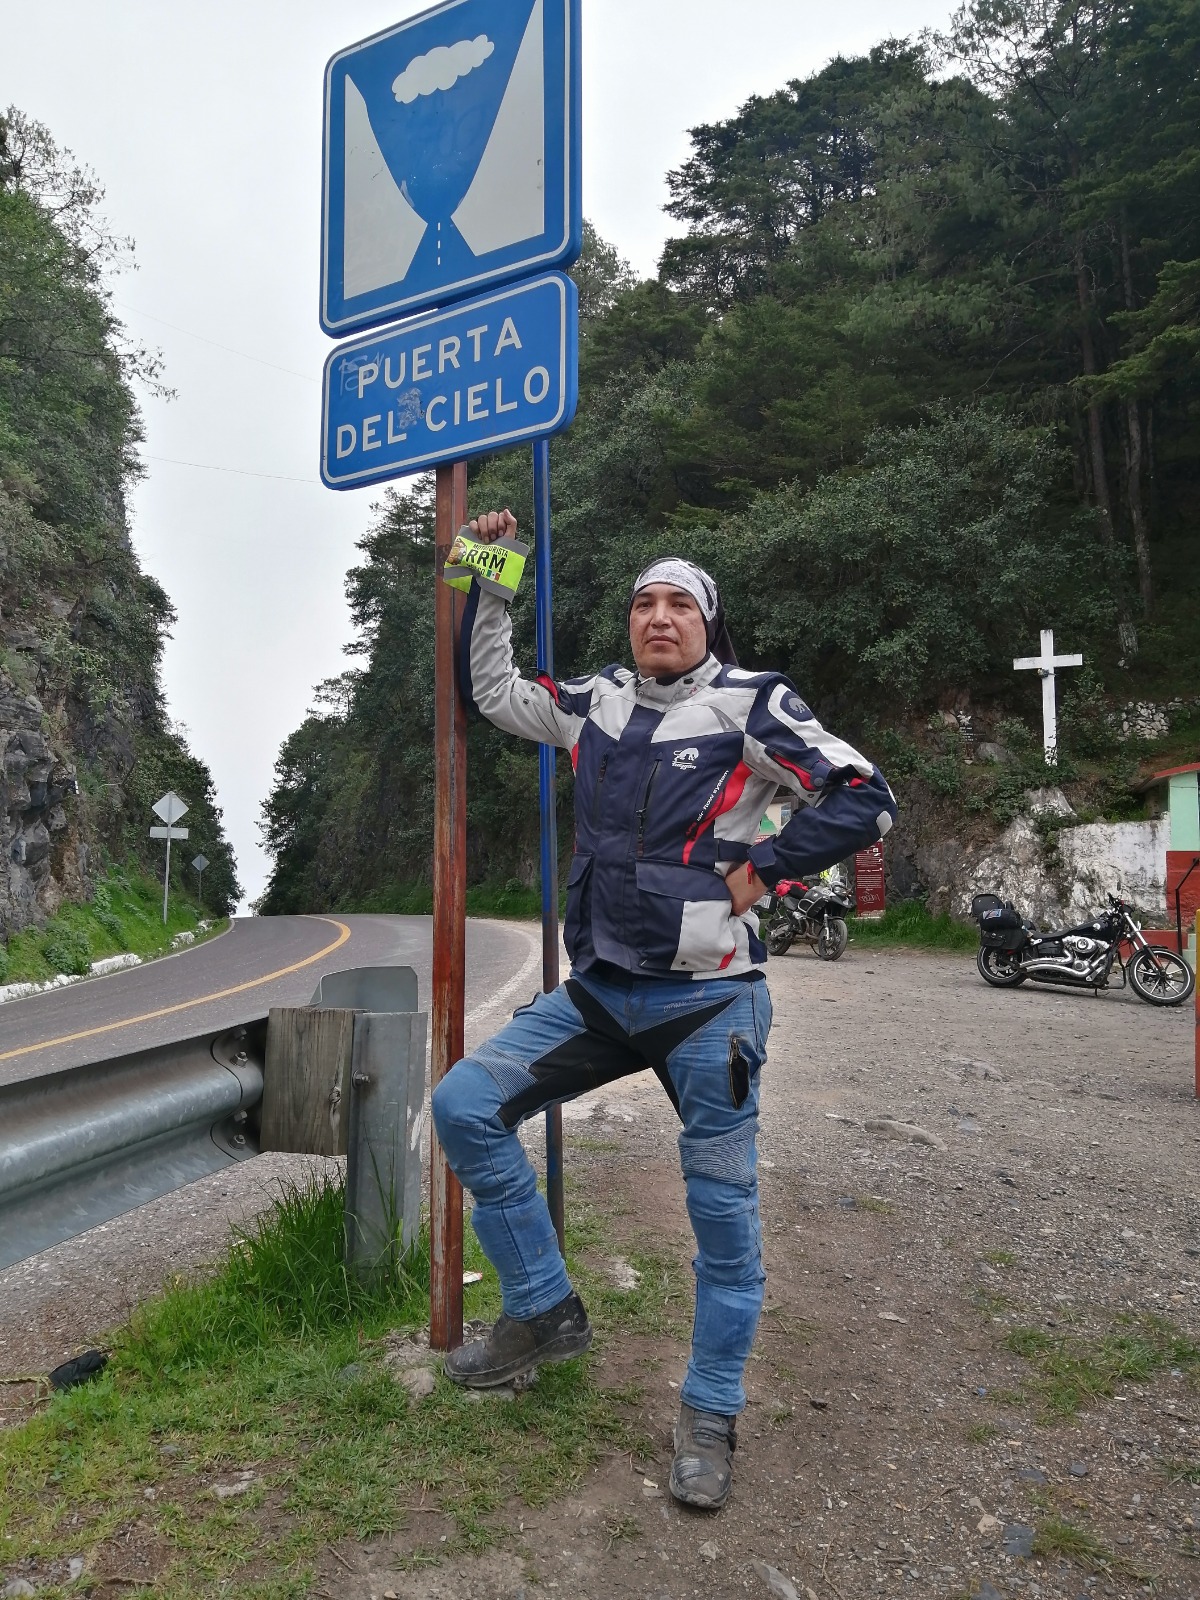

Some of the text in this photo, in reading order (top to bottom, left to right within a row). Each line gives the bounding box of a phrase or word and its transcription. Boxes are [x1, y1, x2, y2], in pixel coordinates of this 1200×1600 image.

[358, 316, 522, 399] PUERTA
[336, 410, 407, 459] DEL
[425, 365, 550, 432] CIELO
[466, 549, 506, 573] RRM
[713, 770, 729, 794] system
